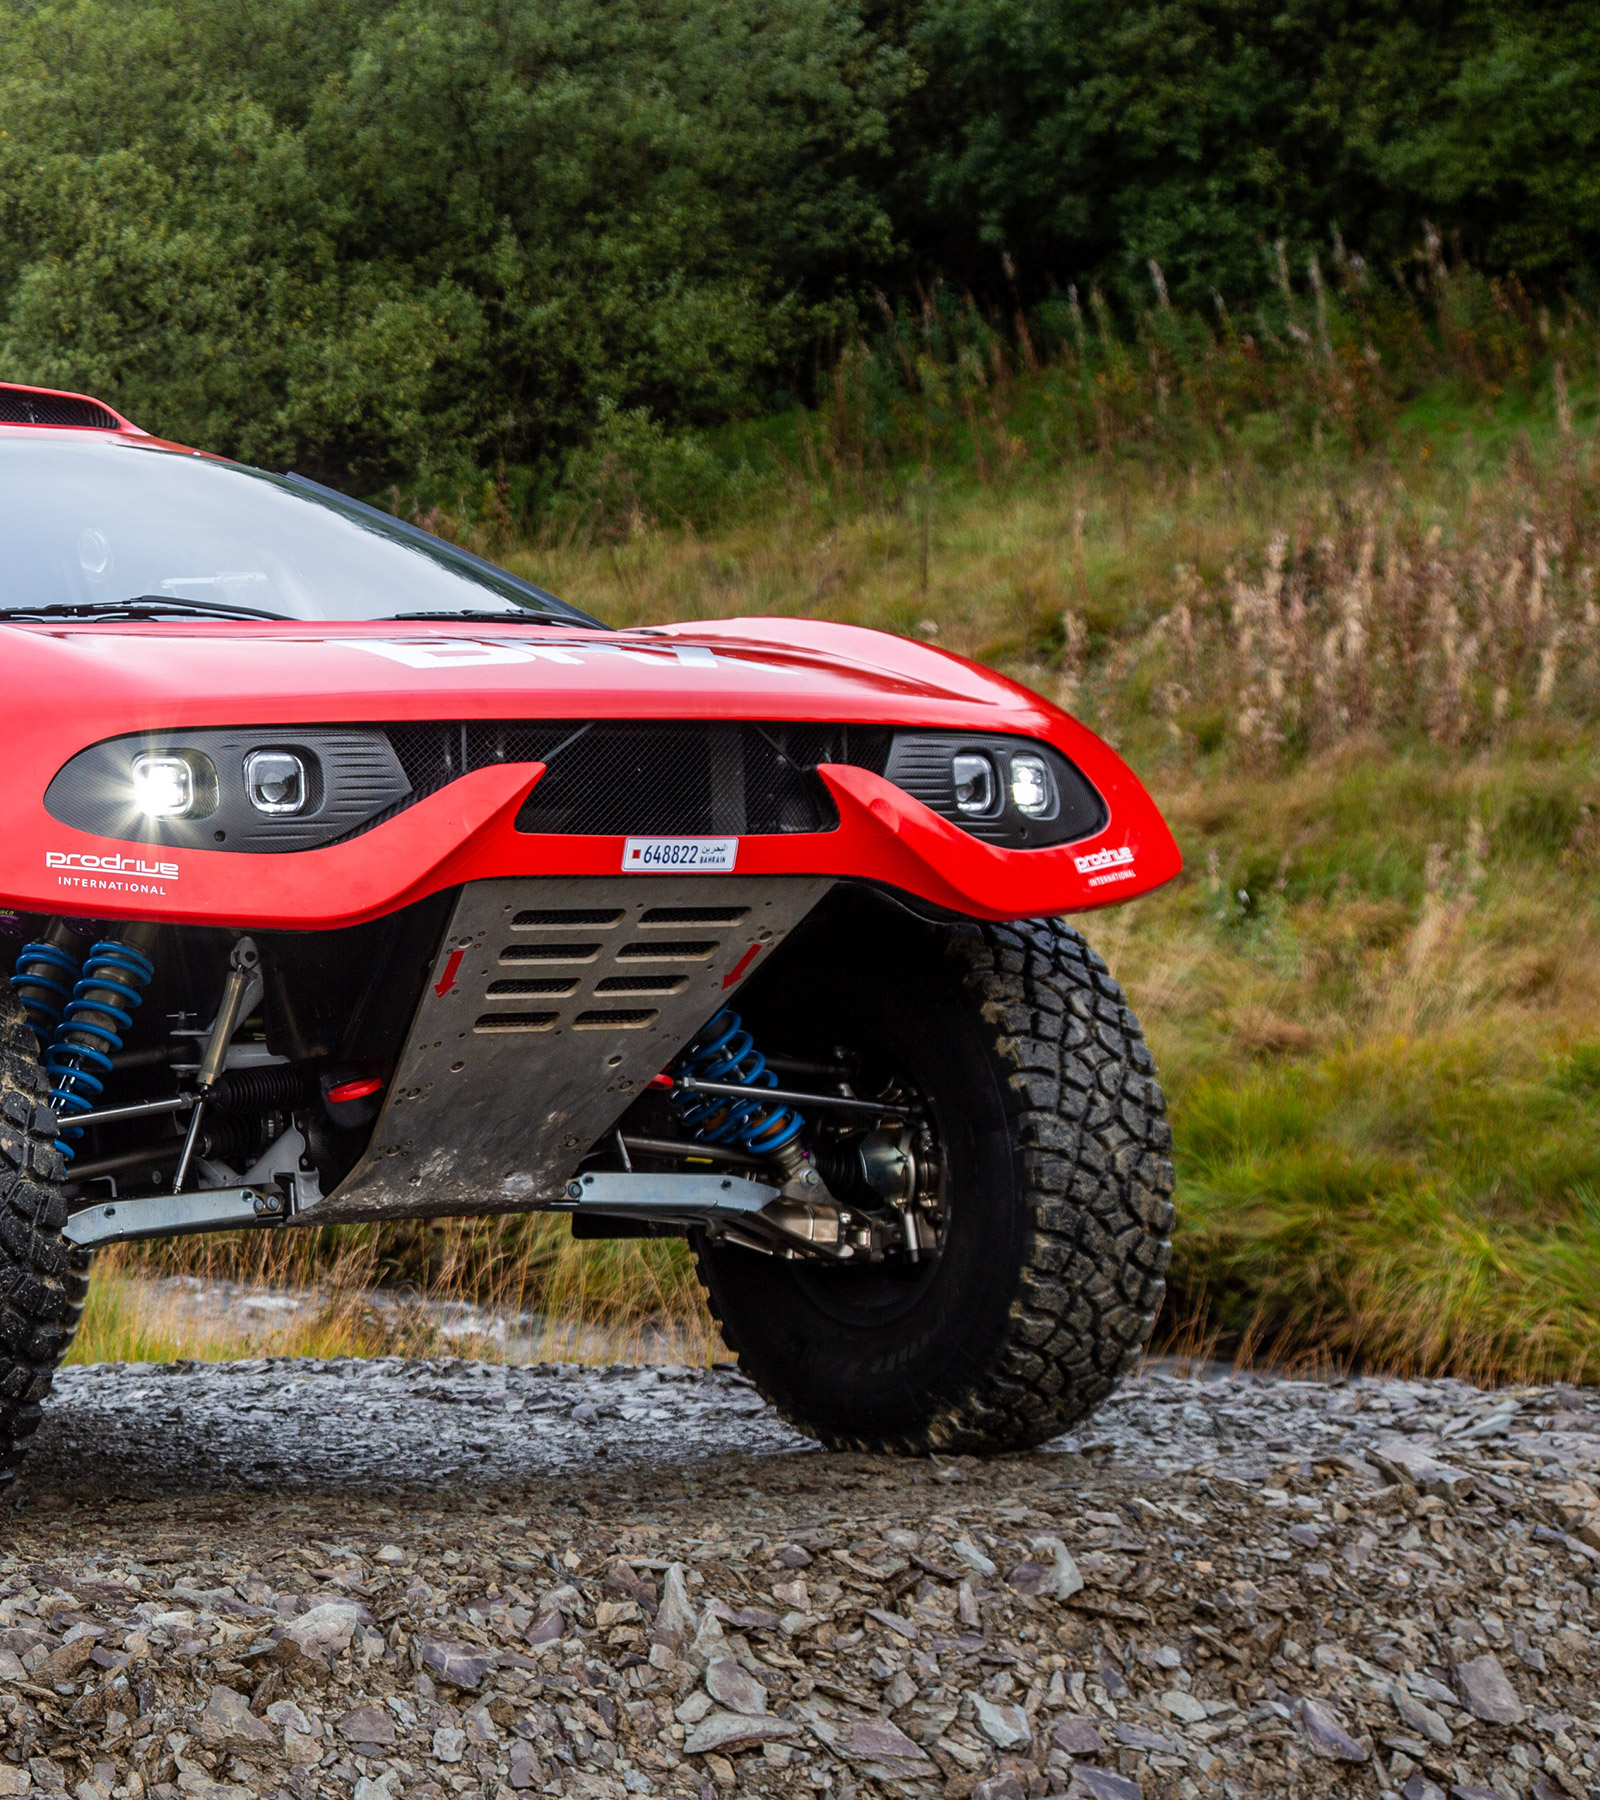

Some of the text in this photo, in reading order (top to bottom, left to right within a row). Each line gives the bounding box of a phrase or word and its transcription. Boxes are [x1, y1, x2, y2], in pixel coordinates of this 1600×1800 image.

[46, 851, 179, 877] prodrive
[643, 845, 699, 864] 648822
[699, 856, 726, 864] BAHRAIN
[1074, 847, 1134, 874] prodrive
[58, 876, 167, 896] INTERNATIONAL
[1088, 869, 1137, 887] INTERNATIONAL
